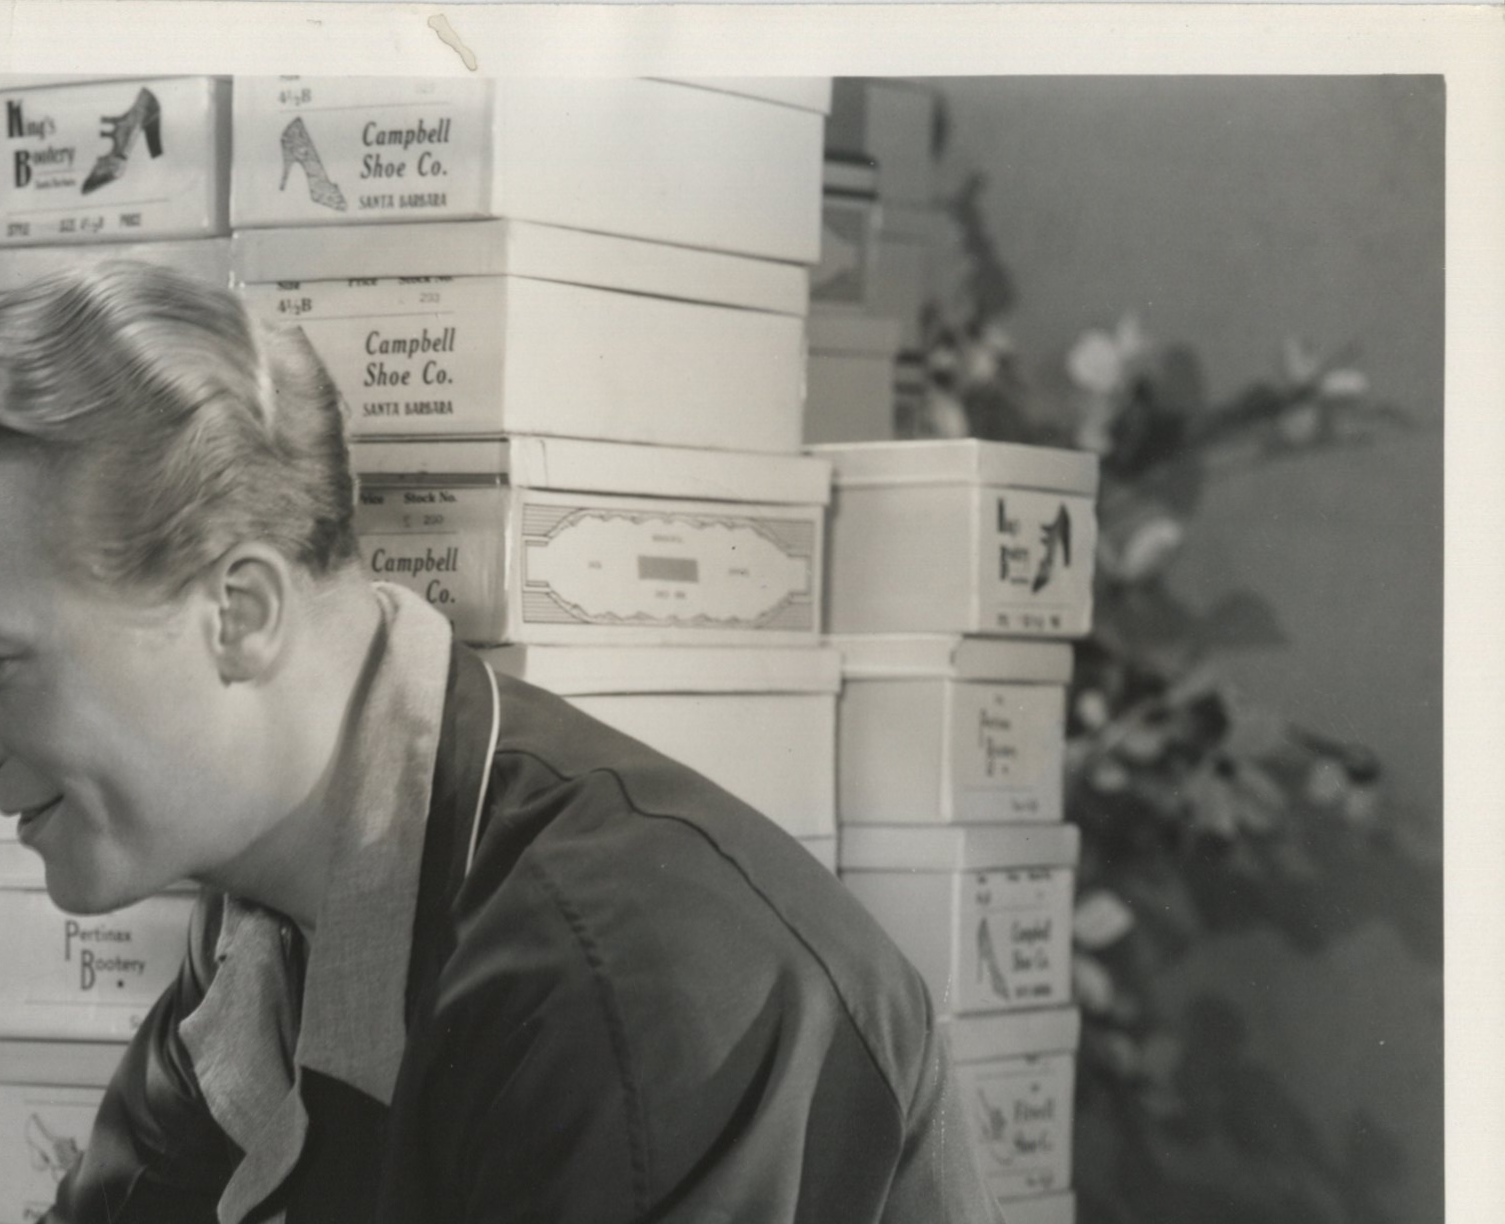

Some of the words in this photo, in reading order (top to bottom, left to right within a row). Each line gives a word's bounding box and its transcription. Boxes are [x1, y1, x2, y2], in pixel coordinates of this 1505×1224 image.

[7, 99, 56, 140] King's
[362, 118, 451, 150] Campbell
[14, 146, 76, 189] Bootery
[360, 153, 406, 179] Shoe
[417, 152, 448, 177] Co.
[358, 194, 394, 210] SANTA
[399, 193, 447, 209] BARBARA
[365, 327, 456, 359] Campbell
[363, 362, 411, 388] Shoe
[422, 360, 454, 385] Co.
[362, 401, 400, 417] SANTA
[404, 400, 454, 415] BARBARA
[403, 491, 436, 504] Stock
[371, 547, 458, 578] Campbell
[426, 579, 456, 604] Co.
[64, 919, 132, 962] Pertinax
[80, 949, 146, 991] Bootery
